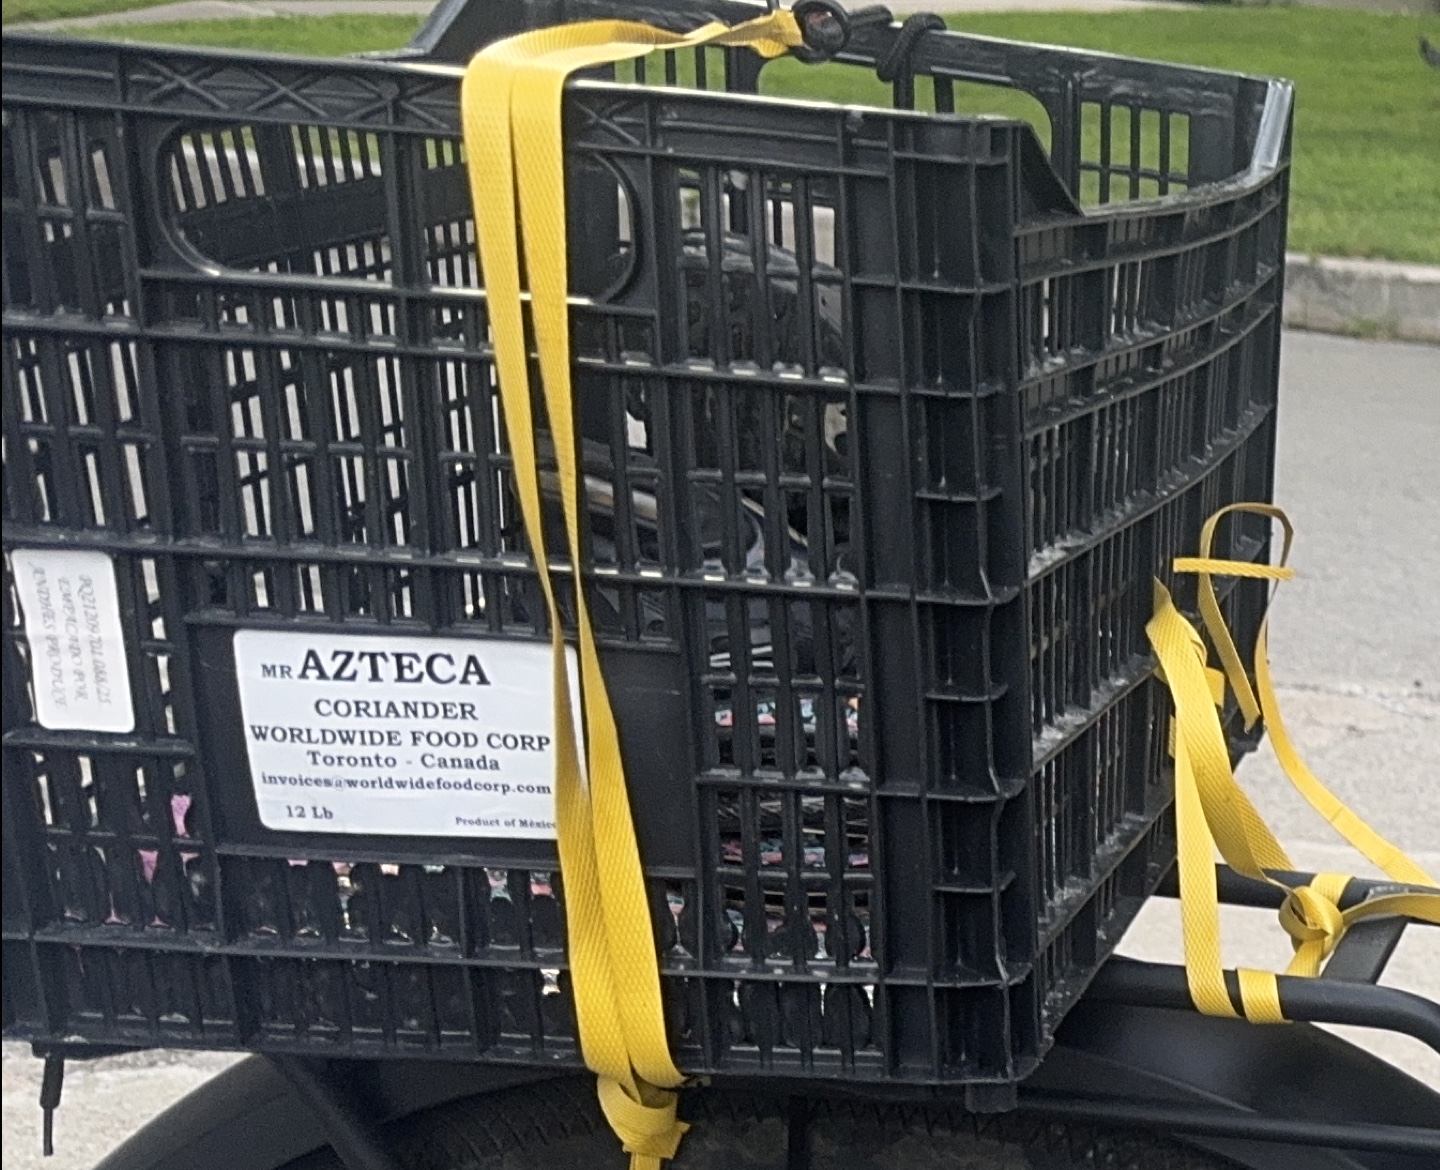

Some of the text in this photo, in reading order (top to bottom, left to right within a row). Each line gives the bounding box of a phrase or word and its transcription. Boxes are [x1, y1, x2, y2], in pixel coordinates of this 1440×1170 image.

[261, 648, 491, 686] MR AZTECA
[314, 698, 479, 721] CORIANDER
[250, 724, 551, 751] WORLDWIDE FOOD CORP
[306, 750, 397, 768] Toronto
[420, 753, 500, 770] Canada
[261, 771, 552, 795] invoices@worldwidefoodcorp.com
[286, 805, 334, 820] 12 Lb
[455, 816, 500, 827] Product
[503, 818, 516, 828] of
